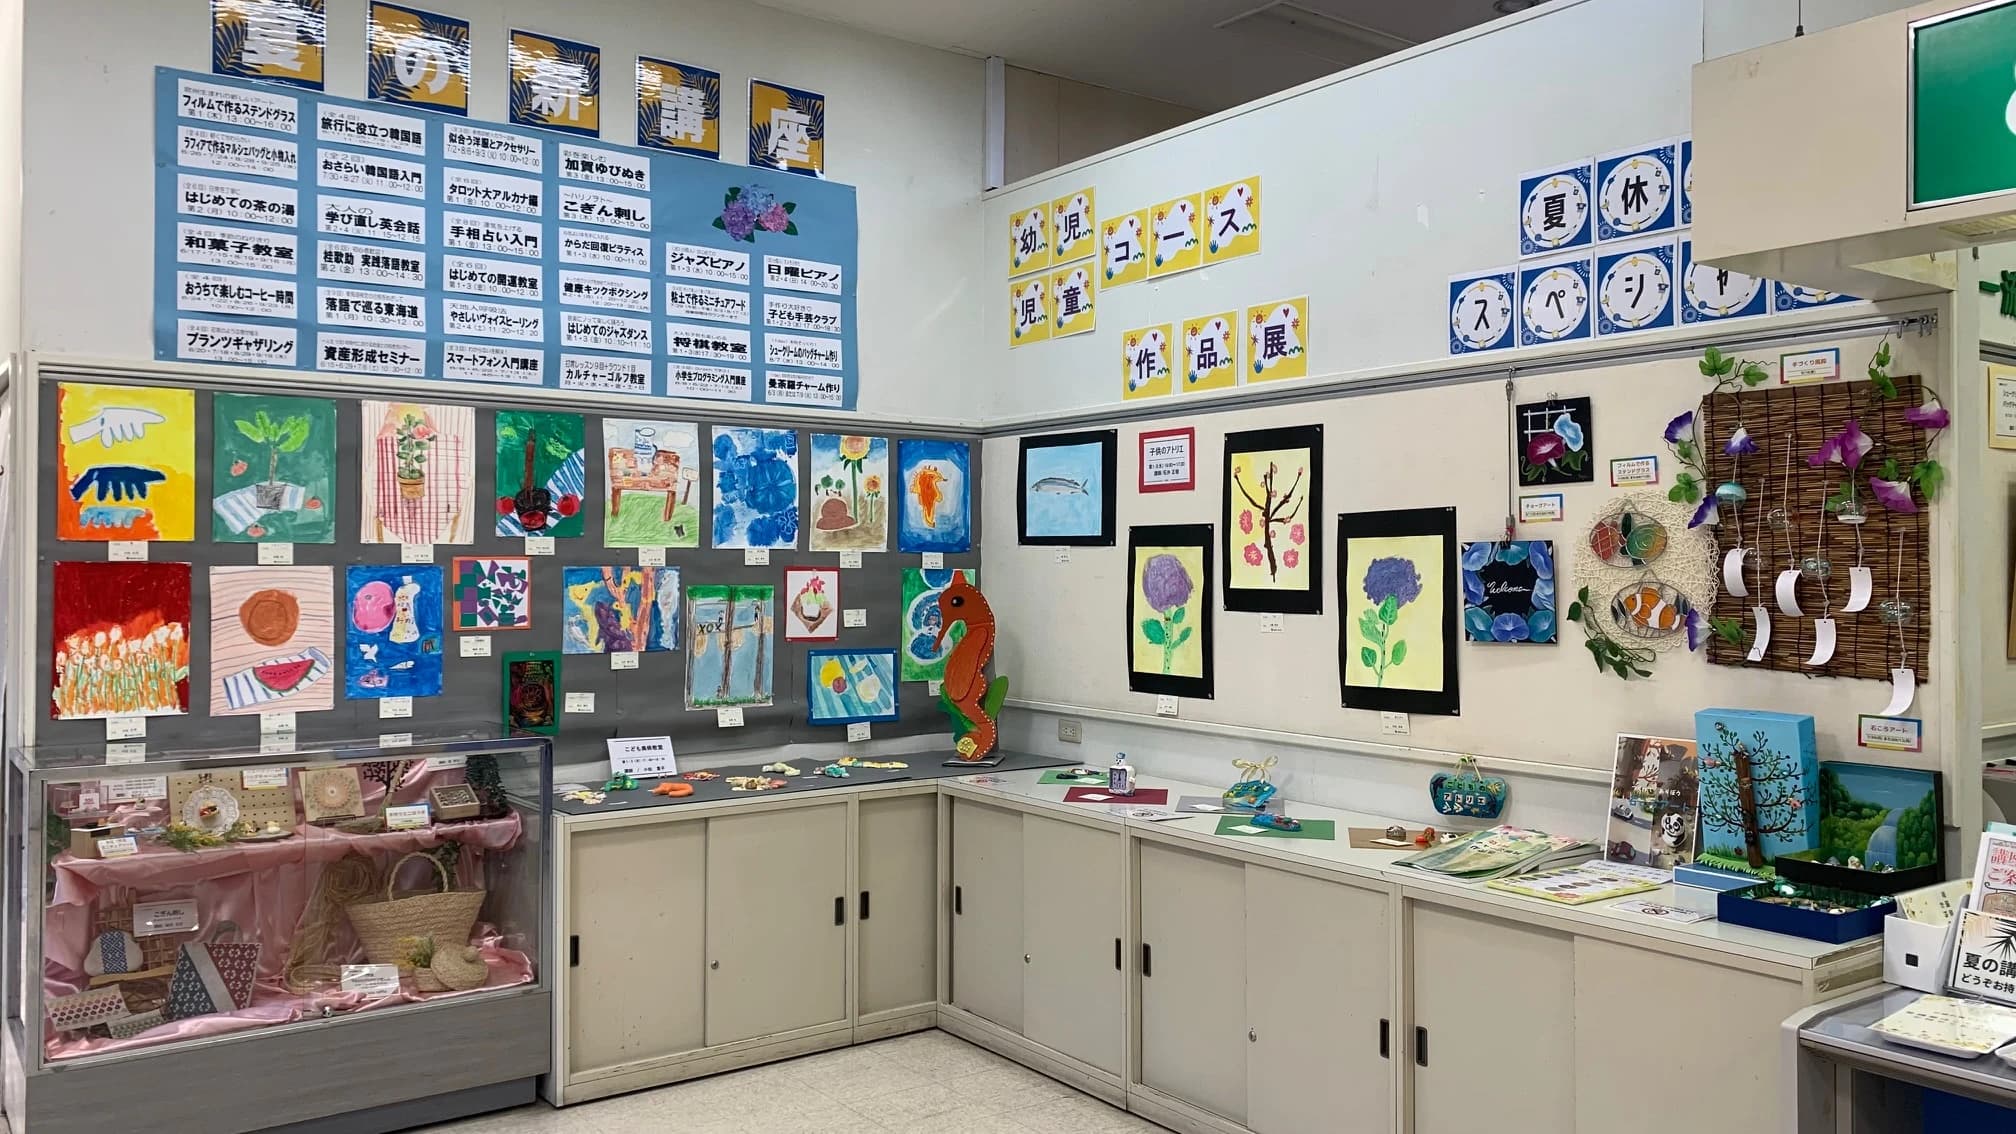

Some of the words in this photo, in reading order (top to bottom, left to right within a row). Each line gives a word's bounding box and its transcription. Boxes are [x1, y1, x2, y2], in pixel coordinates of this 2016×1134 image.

[183, 94, 296, 123] フィルムで作るステンドグラス
[321, 117, 422, 145] 旅行に役立つ韓国語
[184, 137, 296, 163] ラフィアで作るマルシェバッグと小物入れ
[448, 132, 536, 155] 似合う洋服とアクセサリー
[322, 159, 422, 184] おさらい韓国語入門
[565, 158, 646, 182] 加賀ゆびぬき
[185, 191, 295, 216] はじめての茶の湯
[449, 183, 539, 207] タロット大アルカナ編
[325, 203, 374, 215] 大人の
[564, 200, 646, 222] こぎん刺し
[325, 211, 421, 234] 学び直し英会話
[1020, 211, 1082, 255] 幼児
[450, 225, 539, 248] 手相占い入門
[1115, 208, 1239, 263] コース
[184, 236, 294, 260] 和菓子教室
[565, 238, 645, 257] からだ回復ピラティス
[323, 250, 355, 266] 桂歌助
[361, 254, 420, 274] 実践落語教室
[671, 252, 745, 272] ジャズピアノ
[768, 264, 839, 281] 日曜ピアノ
[449, 268, 539, 290] はじめての開運教室
[185, 281, 294, 305] おうちで楽しむコーヒー時間
[564, 282, 648, 300] 健康キックボクシング
[671, 291, 746, 311] 粘土で作るミニチュアフード
[325, 297, 419, 319] 落語で巡る東海道
[768, 309, 837, 325] 子ども手芸クラブ
[1020, 286, 1082, 326] 児童
[450, 311, 540, 329] やさしいヴォイスヒーリング
[568, 322, 648, 341] はじめてのジャズダンス
[186, 332, 294, 354] プランツギャザリング
[673, 337, 748, 354] 将棋教室
[1135, 324, 1288, 380] 作品展
[324, 345, 421, 365] 資産形成セミナー
[446, 352, 540, 371] スマートフォン入門講座
[566, 369, 645, 385] カルチャーゴルフ教室
[675, 370, 746, 386] 小学生プログラミング入門講座
[769, 378, 840, 394] 曼荼羅チャーム作り
